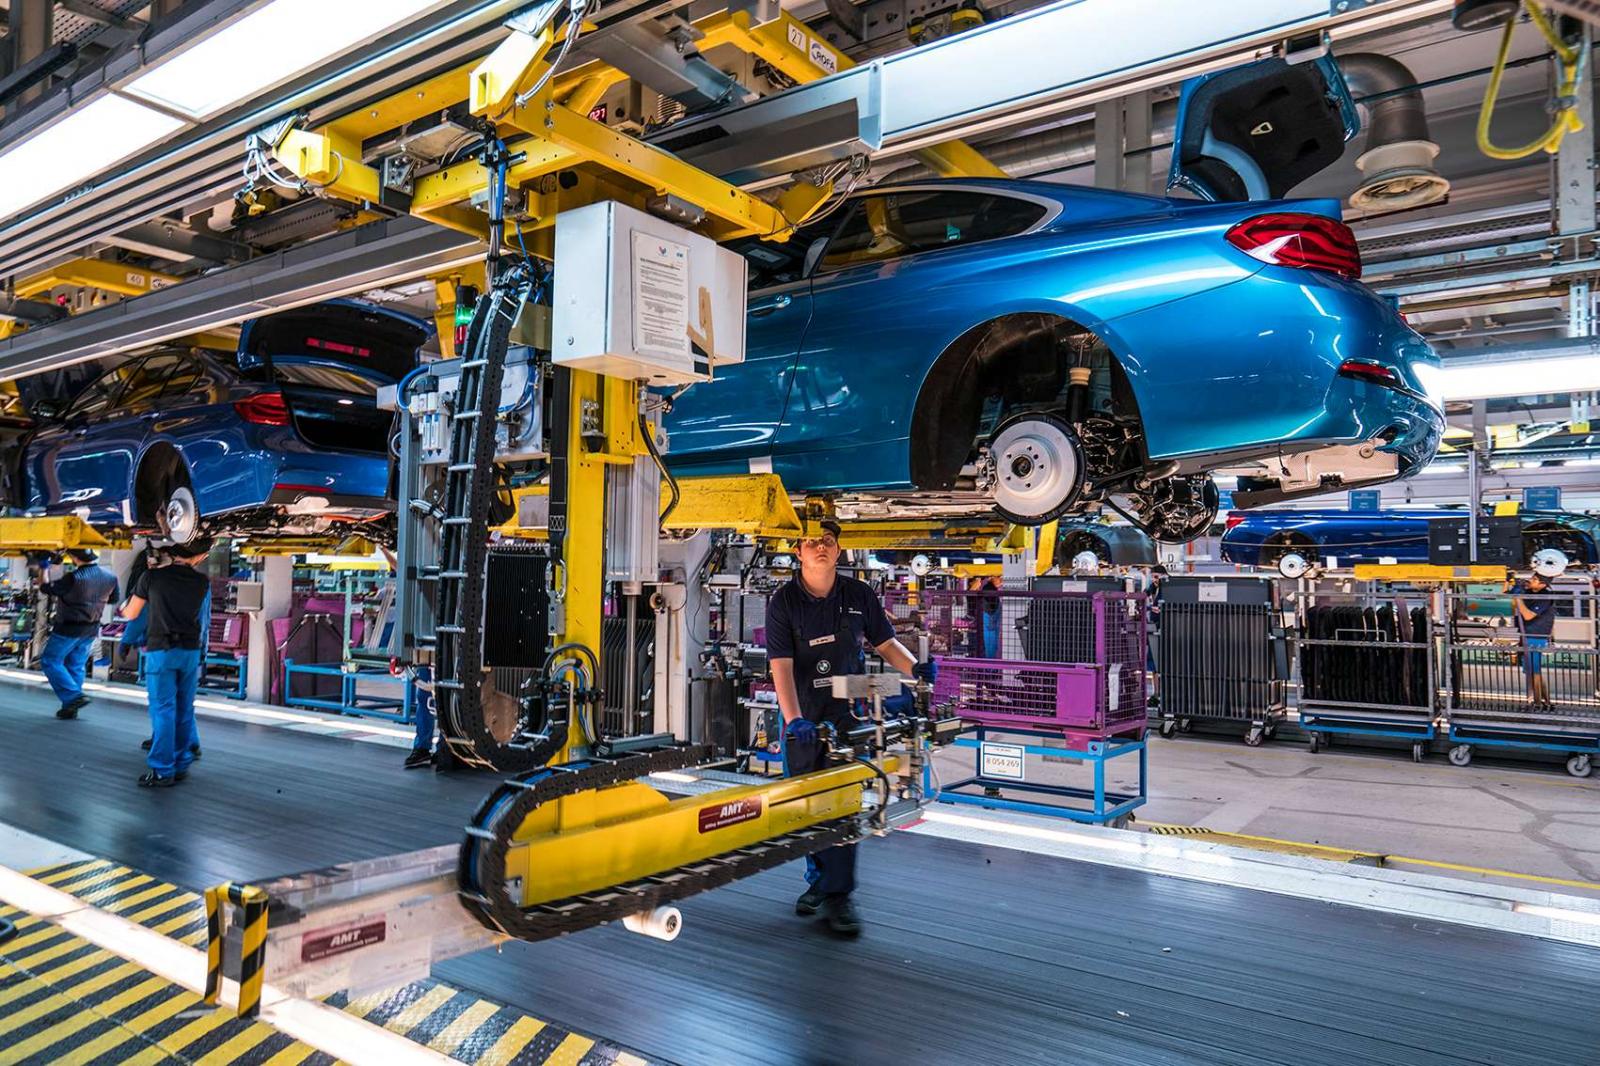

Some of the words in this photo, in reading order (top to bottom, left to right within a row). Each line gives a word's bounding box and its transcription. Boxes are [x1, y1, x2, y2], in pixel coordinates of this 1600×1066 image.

[791, 28, 803, 46] 27
[1006, 759, 1020, 768] 269
[330, 930, 361, 947] AMT
